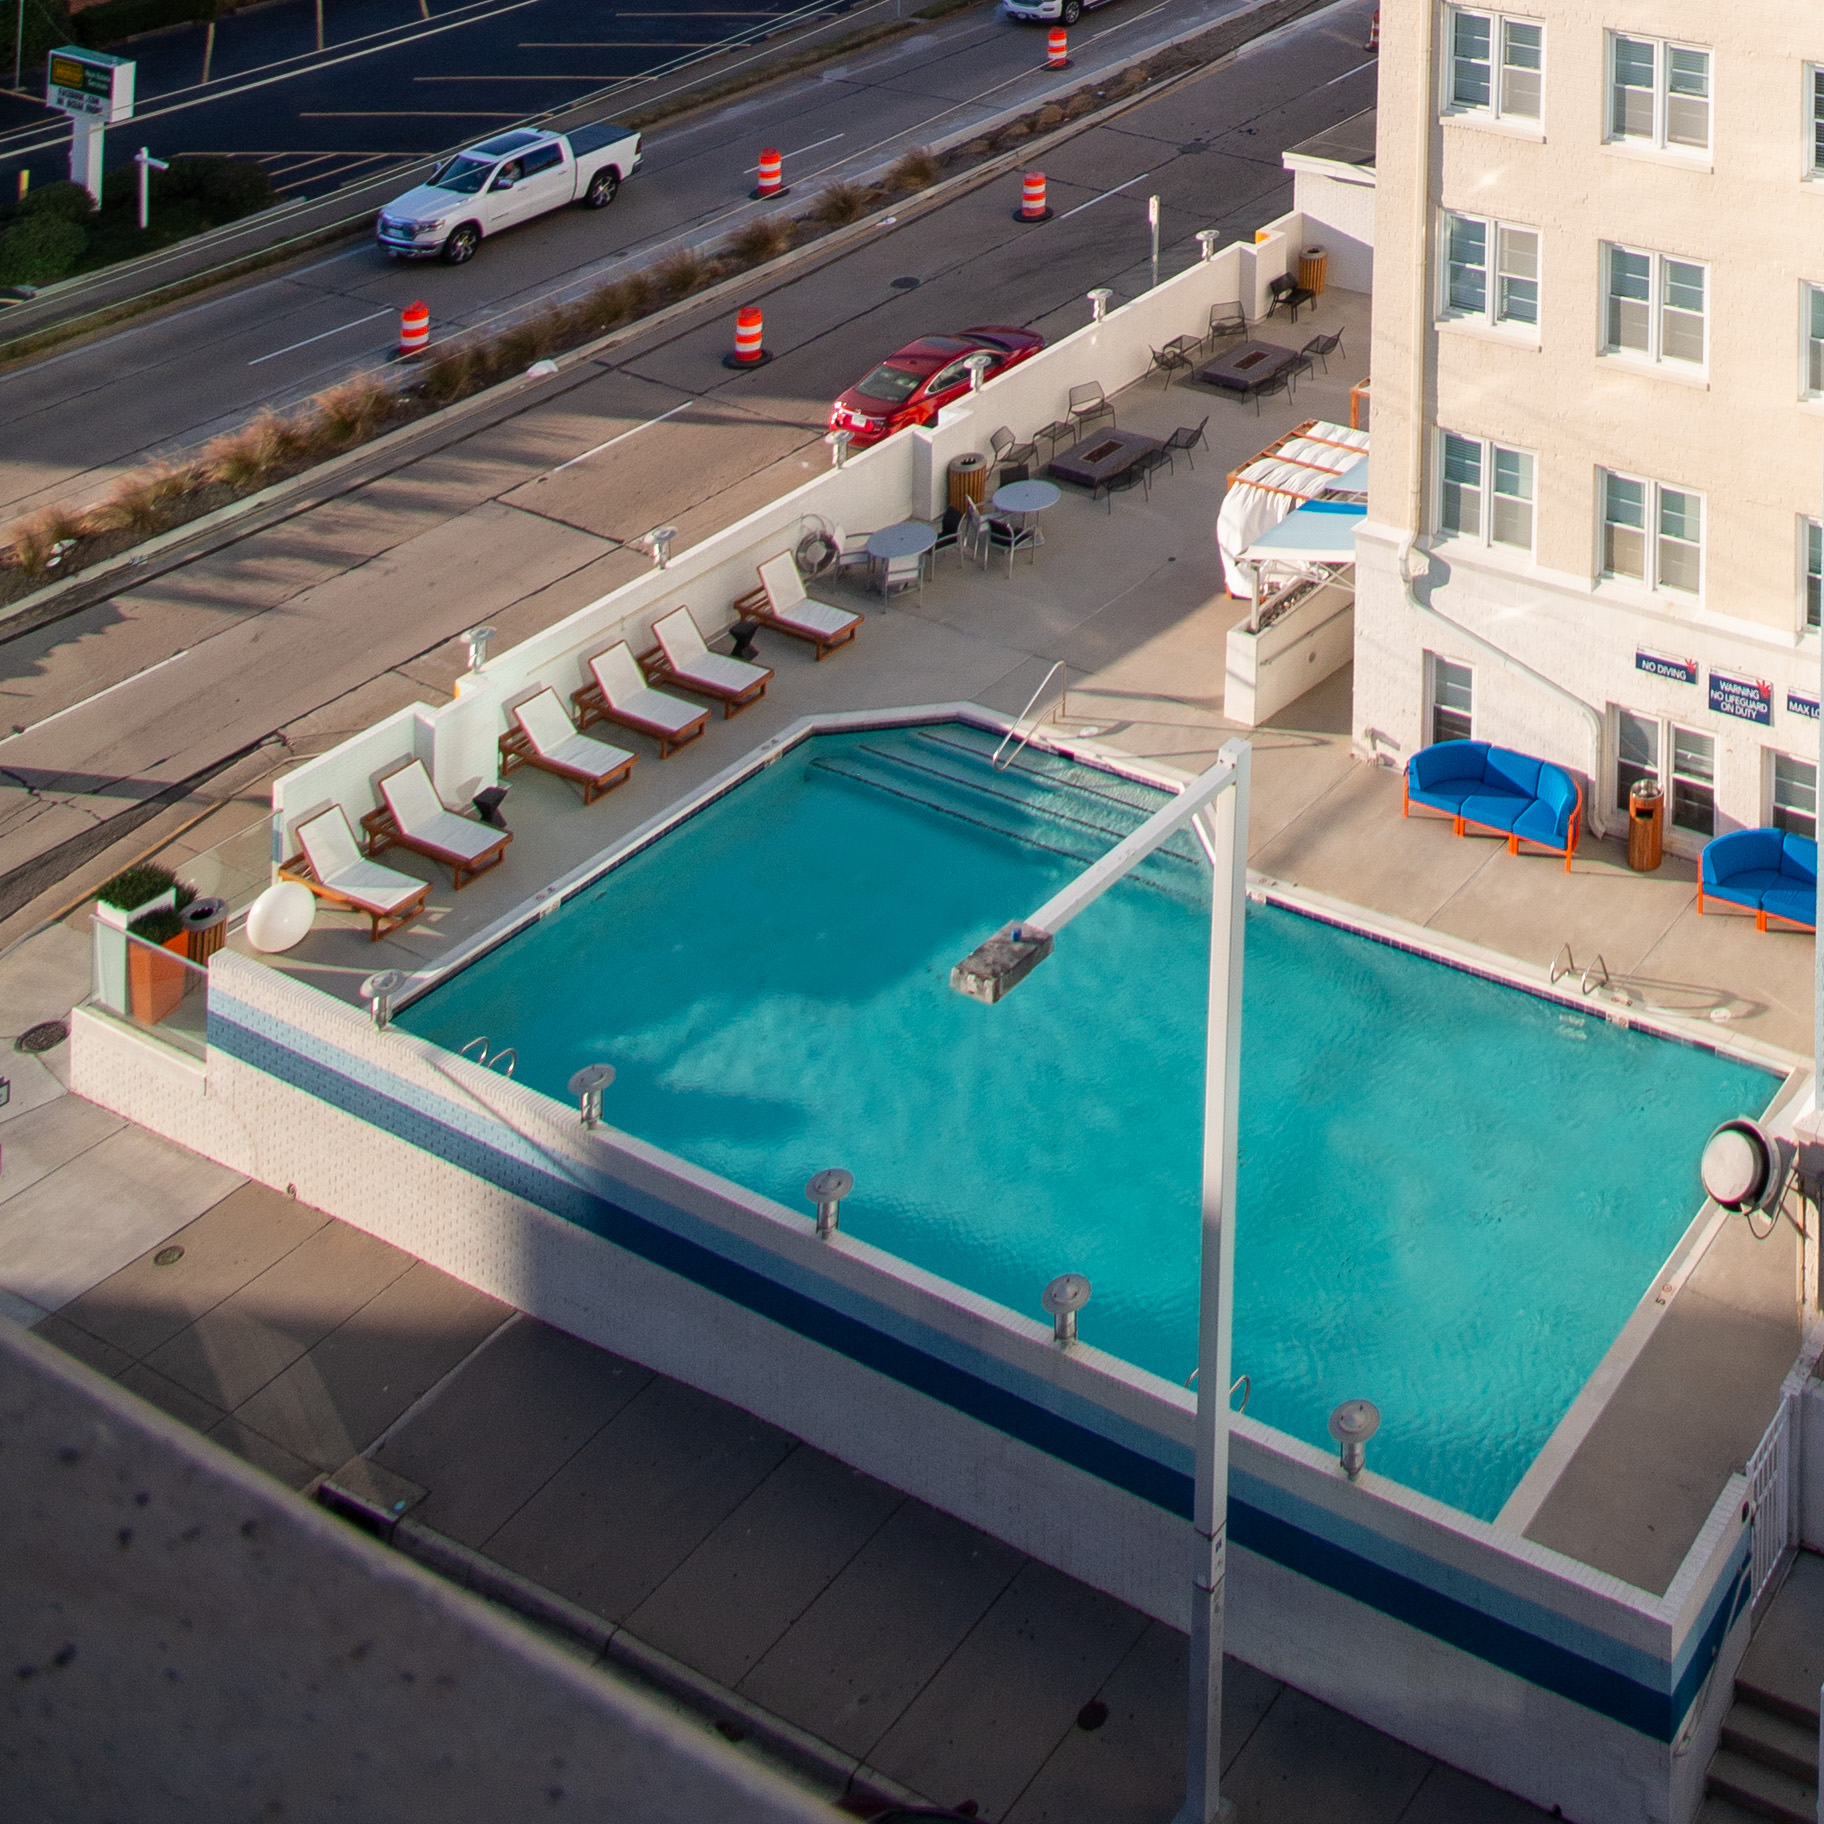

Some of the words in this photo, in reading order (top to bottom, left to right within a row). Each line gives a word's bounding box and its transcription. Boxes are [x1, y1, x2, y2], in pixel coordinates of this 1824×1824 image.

[1642, 659, 1656, 672] NO
[1657, 664, 1687, 681] DIVING
[1719, 680, 1760, 700] WARNING
[1710, 689, 1724, 701] NO
[1725, 693, 1768, 713] LIFEGUARD
[1720, 701, 1734, 713] ON
[1735, 705, 1757, 720] DUTY
[1789, 701, 1809, 716] MAX
